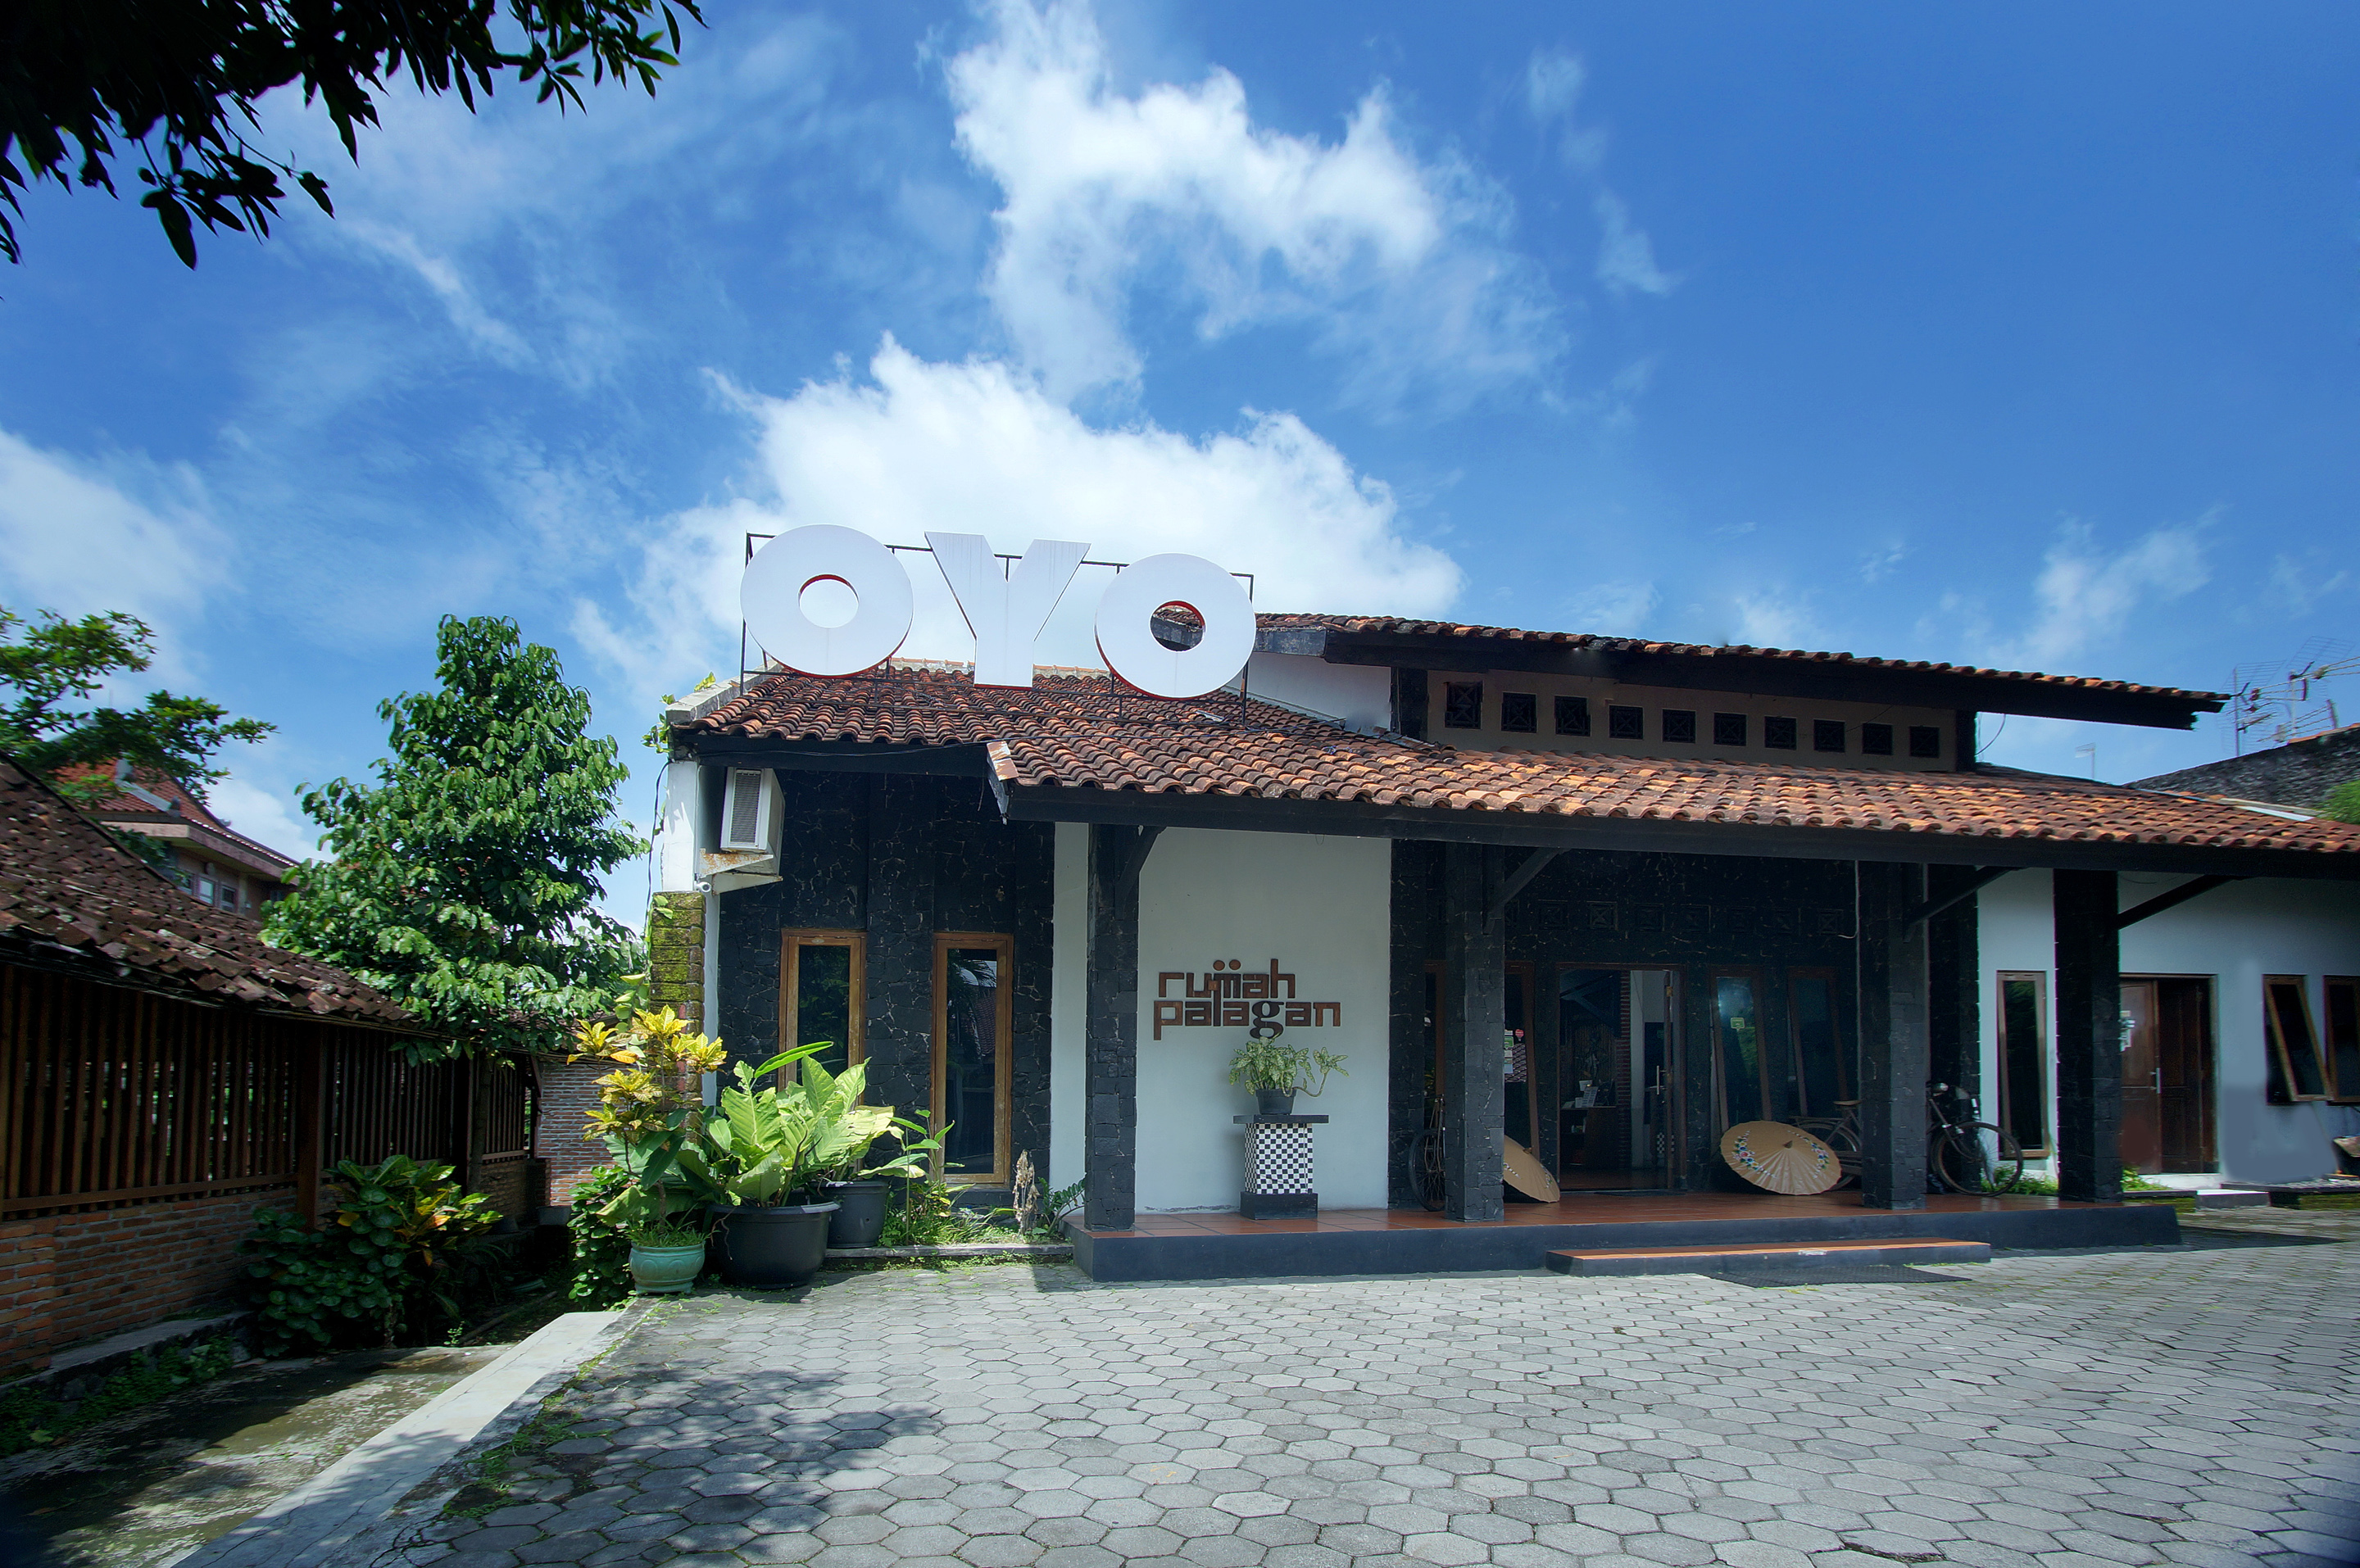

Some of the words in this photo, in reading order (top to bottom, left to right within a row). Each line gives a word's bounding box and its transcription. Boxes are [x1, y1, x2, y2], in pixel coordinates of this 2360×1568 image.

[741, 524, 1255, 700] OYO
[1159, 959, 1296, 999] rumah
[1154, 1000, 1341, 1040] palagan
